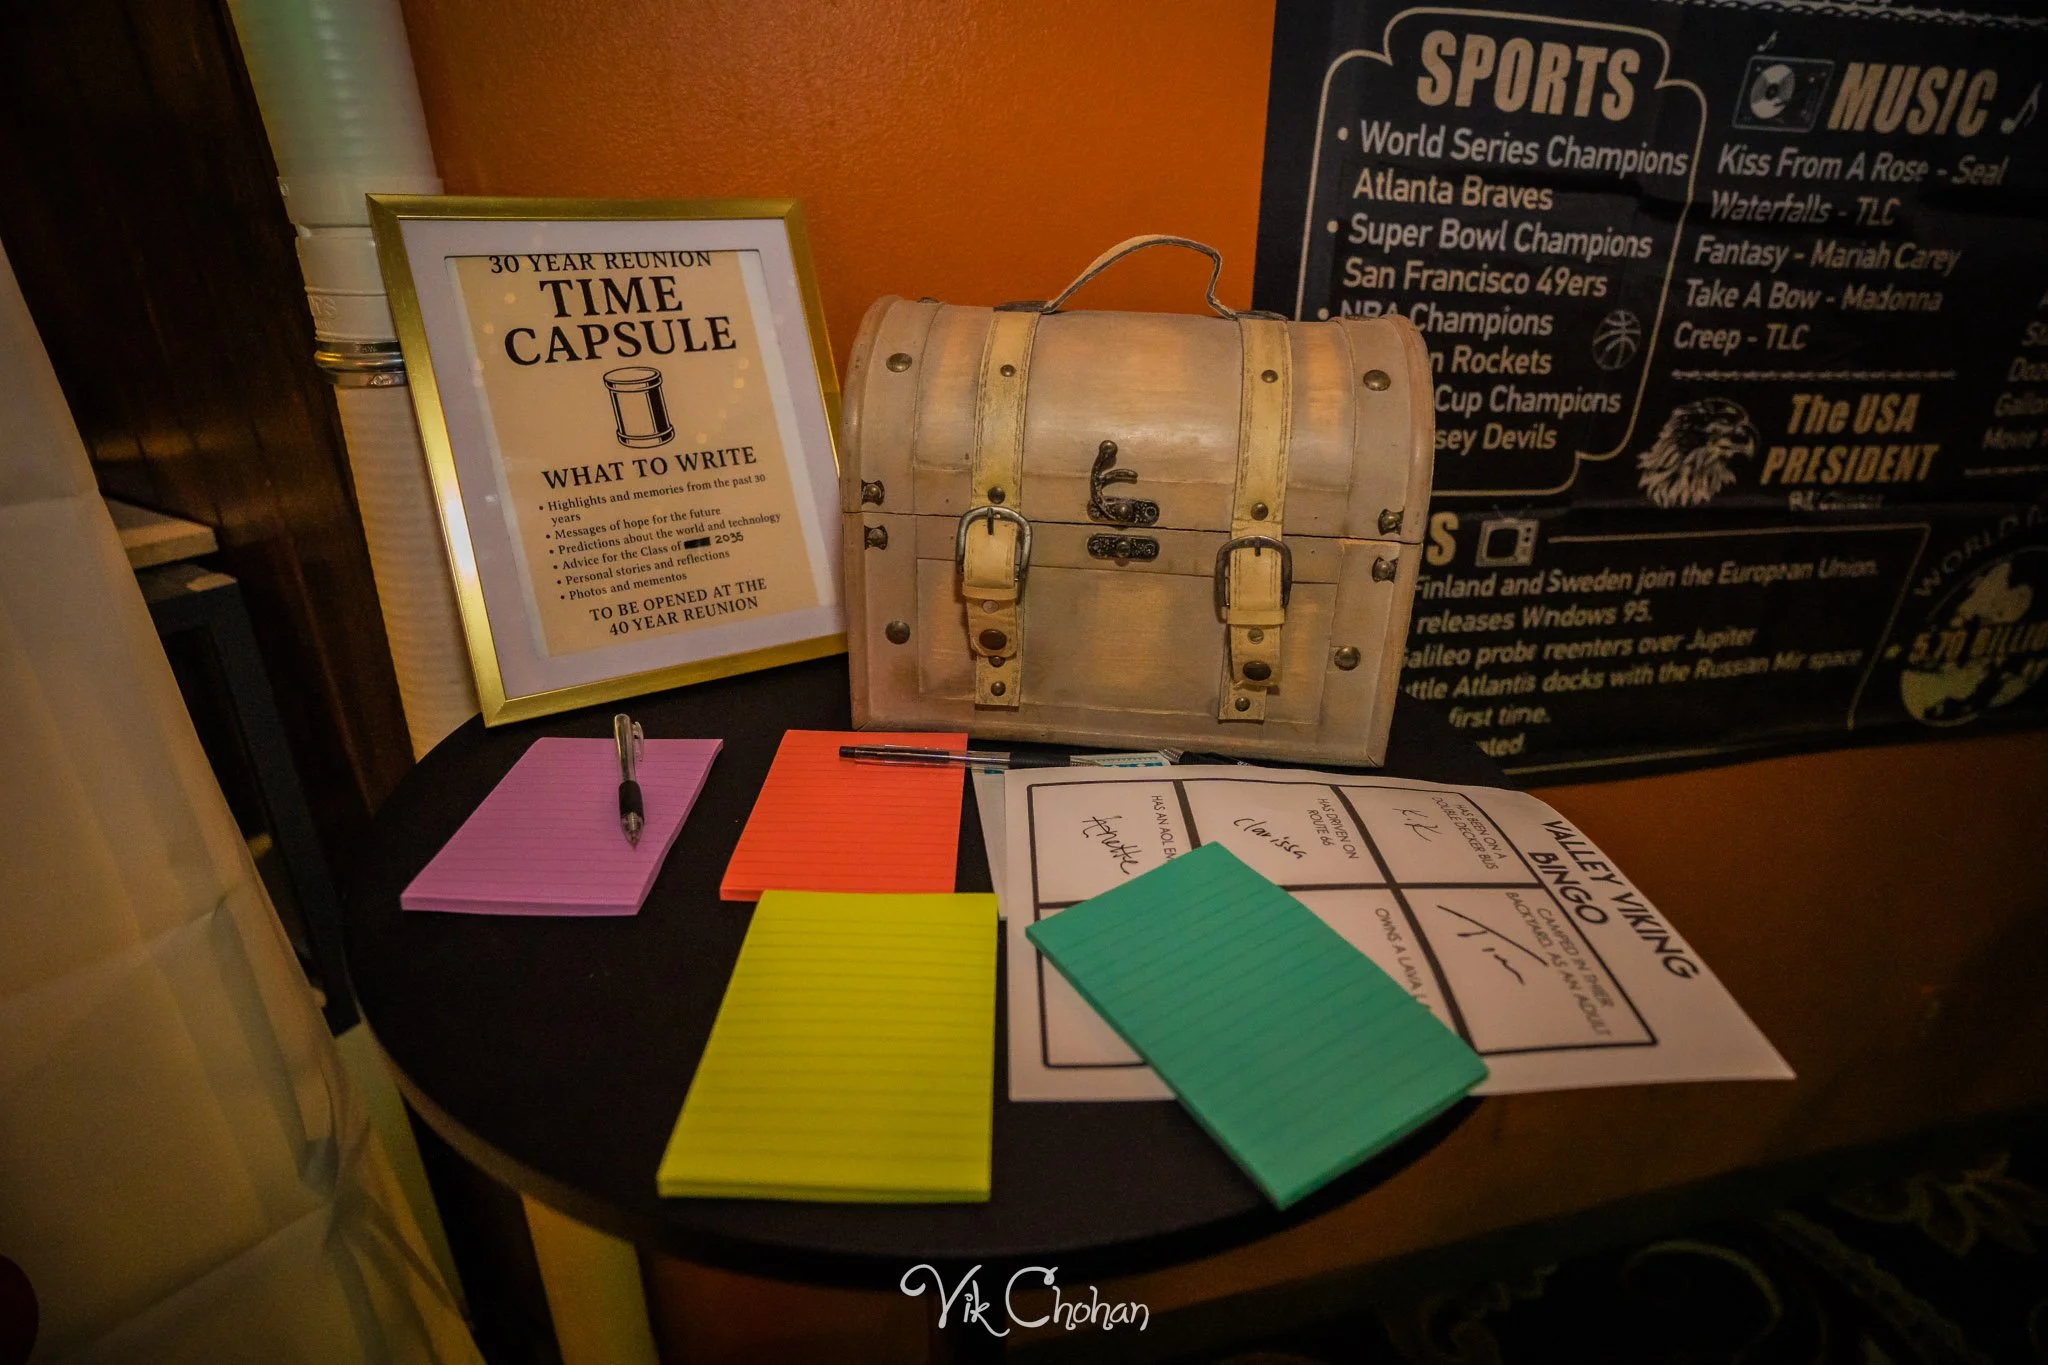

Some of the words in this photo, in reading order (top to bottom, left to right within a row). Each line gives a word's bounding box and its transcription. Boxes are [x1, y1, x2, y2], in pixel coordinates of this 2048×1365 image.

[1417, 29, 1641, 121] SPORTS
[1826, 61, 1999, 137] MUSIC
[1360, 119, 1446, 159] World
[1450, 127, 1539, 166] Series
[1546, 134, 1690, 179] Champions
[1717, 142, 1773, 177] Kiss
[1775, 146, 1842, 181] From
[1845, 151, 1867, 181] A
[1870, 151, 1930, 184] Rose
[1951, 154, 2011, 188] Seal
[1352, 168, 1454, 201] Atlanta
[1461, 174, 1554, 211] Braves
[1709, 189, 1834, 224] Waterfalls
[1855, 195, 1902, 227] TLC
[1348, 212, 1433, 253] Super
[1439, 217, 1507, 251] Bowl
[1514, 221, 1653, 263] Champions
[1694, 234, 1790, 274] Fantasy
[1809, 238, 1890, 269] Mariah
[1893, 242, 1962, 276] Carey
[489, 255, 519, 273] 30
[528, 253, 596, 272] YEAR
[603, 251, 712, 269] REUNION
[1343, 256, 1395, 290] San
[1402, 259, 1530, 295] Francisco
[1535, 266, 1609, 298] 49ers
[539, 276, 683, 318] TIME
[1686, 278, 1740, 309] Take
[1742, 280, 1762, 309] A
[1767, 280, 1823, 310] Bow
[1840, 282, 1944, 312] Madonna
[504, 316, 737, 365] CAPSULE
[1409, 301, 1554, 341] Champions
[1673, 320, 1742, 357] Creep
[1766, 322, 1811, 351] TLC
[1451, 344, 1553, 376] Rockets
[1434, 384, 1483, 419] Cup
[1489, 385, 1622, 420] Champions
[1786, 392, 1850, 435] The
[1852, 392, 1922, 435] USA
[1435, 430, 1478, 456] sey
[1482, 422, 1558, 450] Devils
[541, 462, 624, 489] WHAT
[633, 457, 668, 478] TO
[675, 446, 757, 472] WRITE
[1759, 443, 1941, 486] PRESIDENT
[548, 494, 607, 512] Highlights
[610, 491, 631, 503] and
[633, 485, 684, 498] memories
[687, 478, 712, 491] from
[714, 476, 730, 488] the
[732, 475, 752, 490] past
[754, 474, 766, 483] 30
[551, 513, 581, 526] years
[554, 524, 607, 540] Messages
[609, 520, 621, 531] of
[623, 516, 650, 530] hope
[652, 514, 667, 526] for
[670, 512, 687, 522] the
[689, 507, 721, 520] future
[558, 537, 621, 555] Predictions
[623, 532, 654, 546] about
[656, 528, 674, 538] the
[676, 522, 705, 536] world
[707, 520, 726, 531] and
[728, 512, 781, 528] technology
[715, 531, 745, 545] 2035
[562, 556, 600, 571] Advice
[602, 552, 618, 564] for
[620, 549, 638, 560] the
[640, 543, 669, 557] Class
[671, 540, 682, 551] of
[565, 568, 614, 585] Personal
[615, 563, 652, 577] stories
[654, 558, 674, 570] and
[677, 549, 731, 566] reflections
[569, 585, 608, 600] Photos
[610, 581, 631, 593] and
[633, 572, 688, 589] mementos
[1501, 569, 1545, 596] and
[1545, 566, 1633, 593] Sweden
[1633, 564, 1677, 595] join
[1679, 561, 1715, 587] the
[1717, 560, 1815, 588] European
[589, 606, 613, 621] TO
[618, 601, 640, 616] BE
[643, 588, 708, 612] OPENED
[713, 583, 733, 598] AT
[735, 578, 768, 593] THE
[609, 621, 629, 636] 40
[632, 611, 679, 631] YEAR
[683, 596, 759, 621] REUNION
[1416, 608, 1515, 635] releases
[1404, 641, 1471, 669] alileo
[1637, 634, 1685, 655] over
[1685, 626, 1758, 654] Jupiter
[1452, 671, 1537, 698] Atlantis
[1542, 666, 1606, 693] docks
[1609, 662, 1655, 687] with
[1657, 660, 1692, 681] the
[1449, 705, 1494, 728] first
[1151, 795, 1166, 811] HAS
[1155, 812, 1169, 825] AN
[1160, 827, 1174, 846] AOL
[1307, 809, 1330, 834] ROUTE
[1320, 836, 1335, 846] 66
[1317, 798, 1335, 812] HAS
[1326, 813, 1350, 842] DRIVEN
[1343, 844, 1360, 859] ON
[1431, 797, 1462, 821] DOUBLE
[1454, 822, 1486, 852] DECKER
[1478, 854, 1499, 870] BUS
[1456, 804, 1474, 817] HAS
[1467, 817, 1490, 836] BEEN
[1483, 836, 1502, 851] ON
[1528, 851, 1609, 925] BINGO
[1541, 820, 1626, 887] VALLEY
[1610, 891, 1700, 980] VIKING
